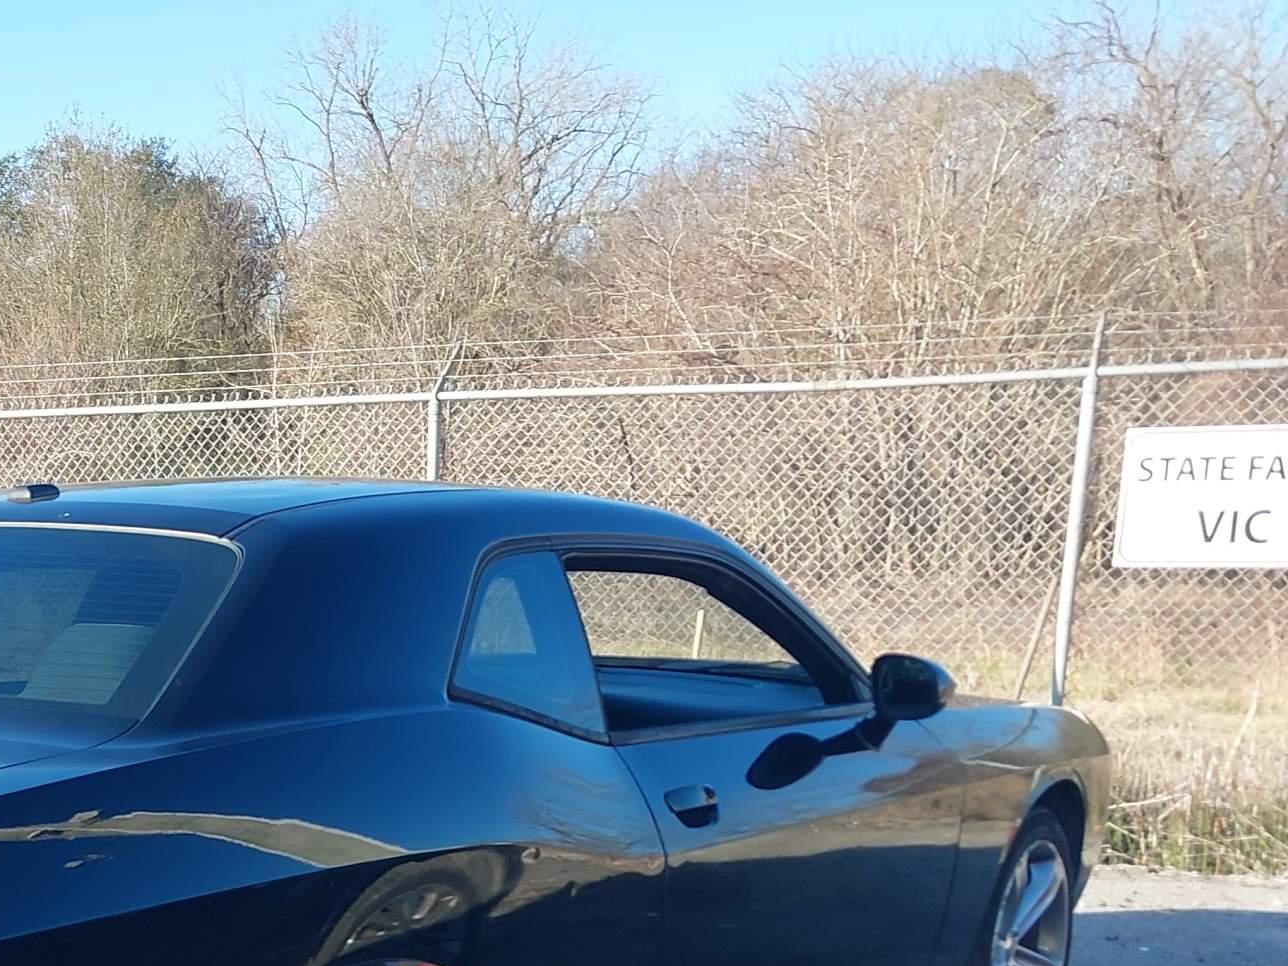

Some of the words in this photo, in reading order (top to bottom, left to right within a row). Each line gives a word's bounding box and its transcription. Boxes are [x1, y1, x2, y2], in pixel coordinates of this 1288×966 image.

[1138, 456, 1236, 482] STATE
[1248, 455, 1287, 481] FA
[1198, 510, 1272, 544] VIC
